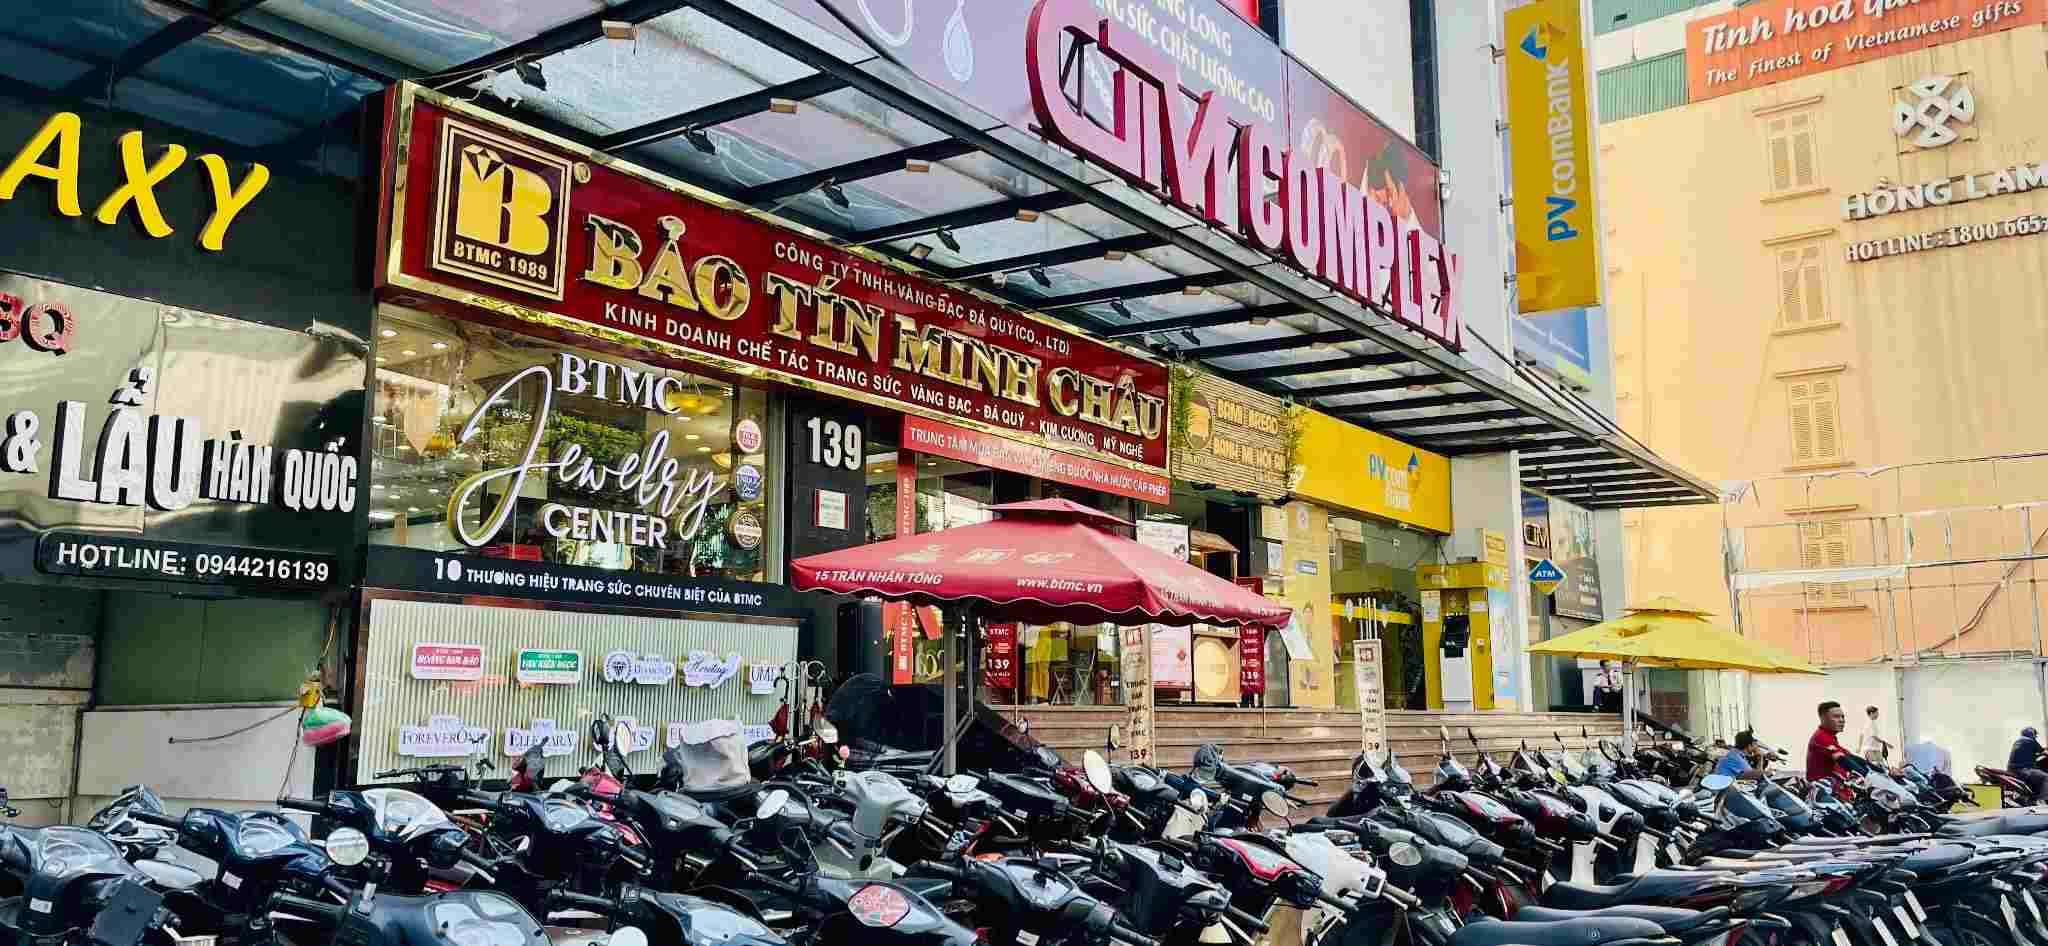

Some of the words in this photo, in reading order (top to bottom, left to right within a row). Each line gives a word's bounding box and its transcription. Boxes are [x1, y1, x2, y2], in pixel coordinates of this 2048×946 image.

[1188, 6, 1232, 57] LONG
[1705, 67, 1737, 87] The
[1810, 42, 1834, 63] of
[1843, 13, 1961, 53] Vietnamese
[1971, 1, 2022, 28] gifts
[1247, 86, 1275, 123] CAO
[1545, 62, 1578, 242] PVcomBank
[1840, 174, 1953, 222] HỒNG
[453, 243, 502, 267] BTMC
[509, 259, 549, 281] 1989
[1238, 124, 1466, 353] COMPLEX
[1844, 229, 1946, 264] HOTLINE:
[1947, 222, 1999, 246] 1800
[775, 241, 824, 272] CÔNG
[831, 260, 850, 280] TY
[853, 268, 894, 294] TNHH
[968, 309, 986, 329] ĐÁ
[989, 316, 1014, 336] QUÝ
[1046, 334, 1071, 356] LTD)
[577, 214, 752, 321] BẢO
[766, 271, 885, 364] TÍN
[892, 312, 1043, 408] MINH
[1046, 365, 1165, 441] CHÂU
[556, 352, 684, 416] BTMC
[604, 301, 658, 332] KINH
[665, 318, 731, 352] DOANH
[737, 337, 773, 362] CHẾ
[778, 347, 809, 372] TÁC
[816, 358, 868, 387] TRANG
[873, 373, 902, 395] SỨC
[910, 384, 944, 408] VÀNG
[948, 396, 972, 418] BẠC
[983, 402, 1000, 423] ĐÁ
[1002, 408, 1026, 429] QUÝ
[1039, 419, 1058, 438] KIM
[1, 410, 41, 474] &
[49, 367, 202, 512] LẨU
[200, 430, 273, 505] HÀN
[282, 436, 358, 513] QUỐC
[455, 364, 728, 548] Jewelry
[807, 416, 863, 470] 139
[911, 427, 945, 448] TRUNG
[542, 502, 668, 549] CENTER
[56, 542, 188, 576] HOTLINE:
[194, 553, 330, 583] 0944216139
[433, 557, 462, 581] 10
[466, 568, 526, 588] THƯƠNG
[529, 570, 558, 592] HIỆU
[562, 577, 605, 594] TRANG
[608, 578, 632, 596] SỨC
[635, 582, 682, 600] CHUYÊN
[684, 585, 706, 603] BIỆT
[708, 588, 732, 604] CỦA
[734, 593, 763, 607] BTMC
[815, 570, 832, 582] 15
[1016, 575, 1104, 595] www.btmc.vn
[1535, 568, 1557, 578] ATM
[987, 657, 1010, 670] 139
[1130, 749, 1147, 760] 139
